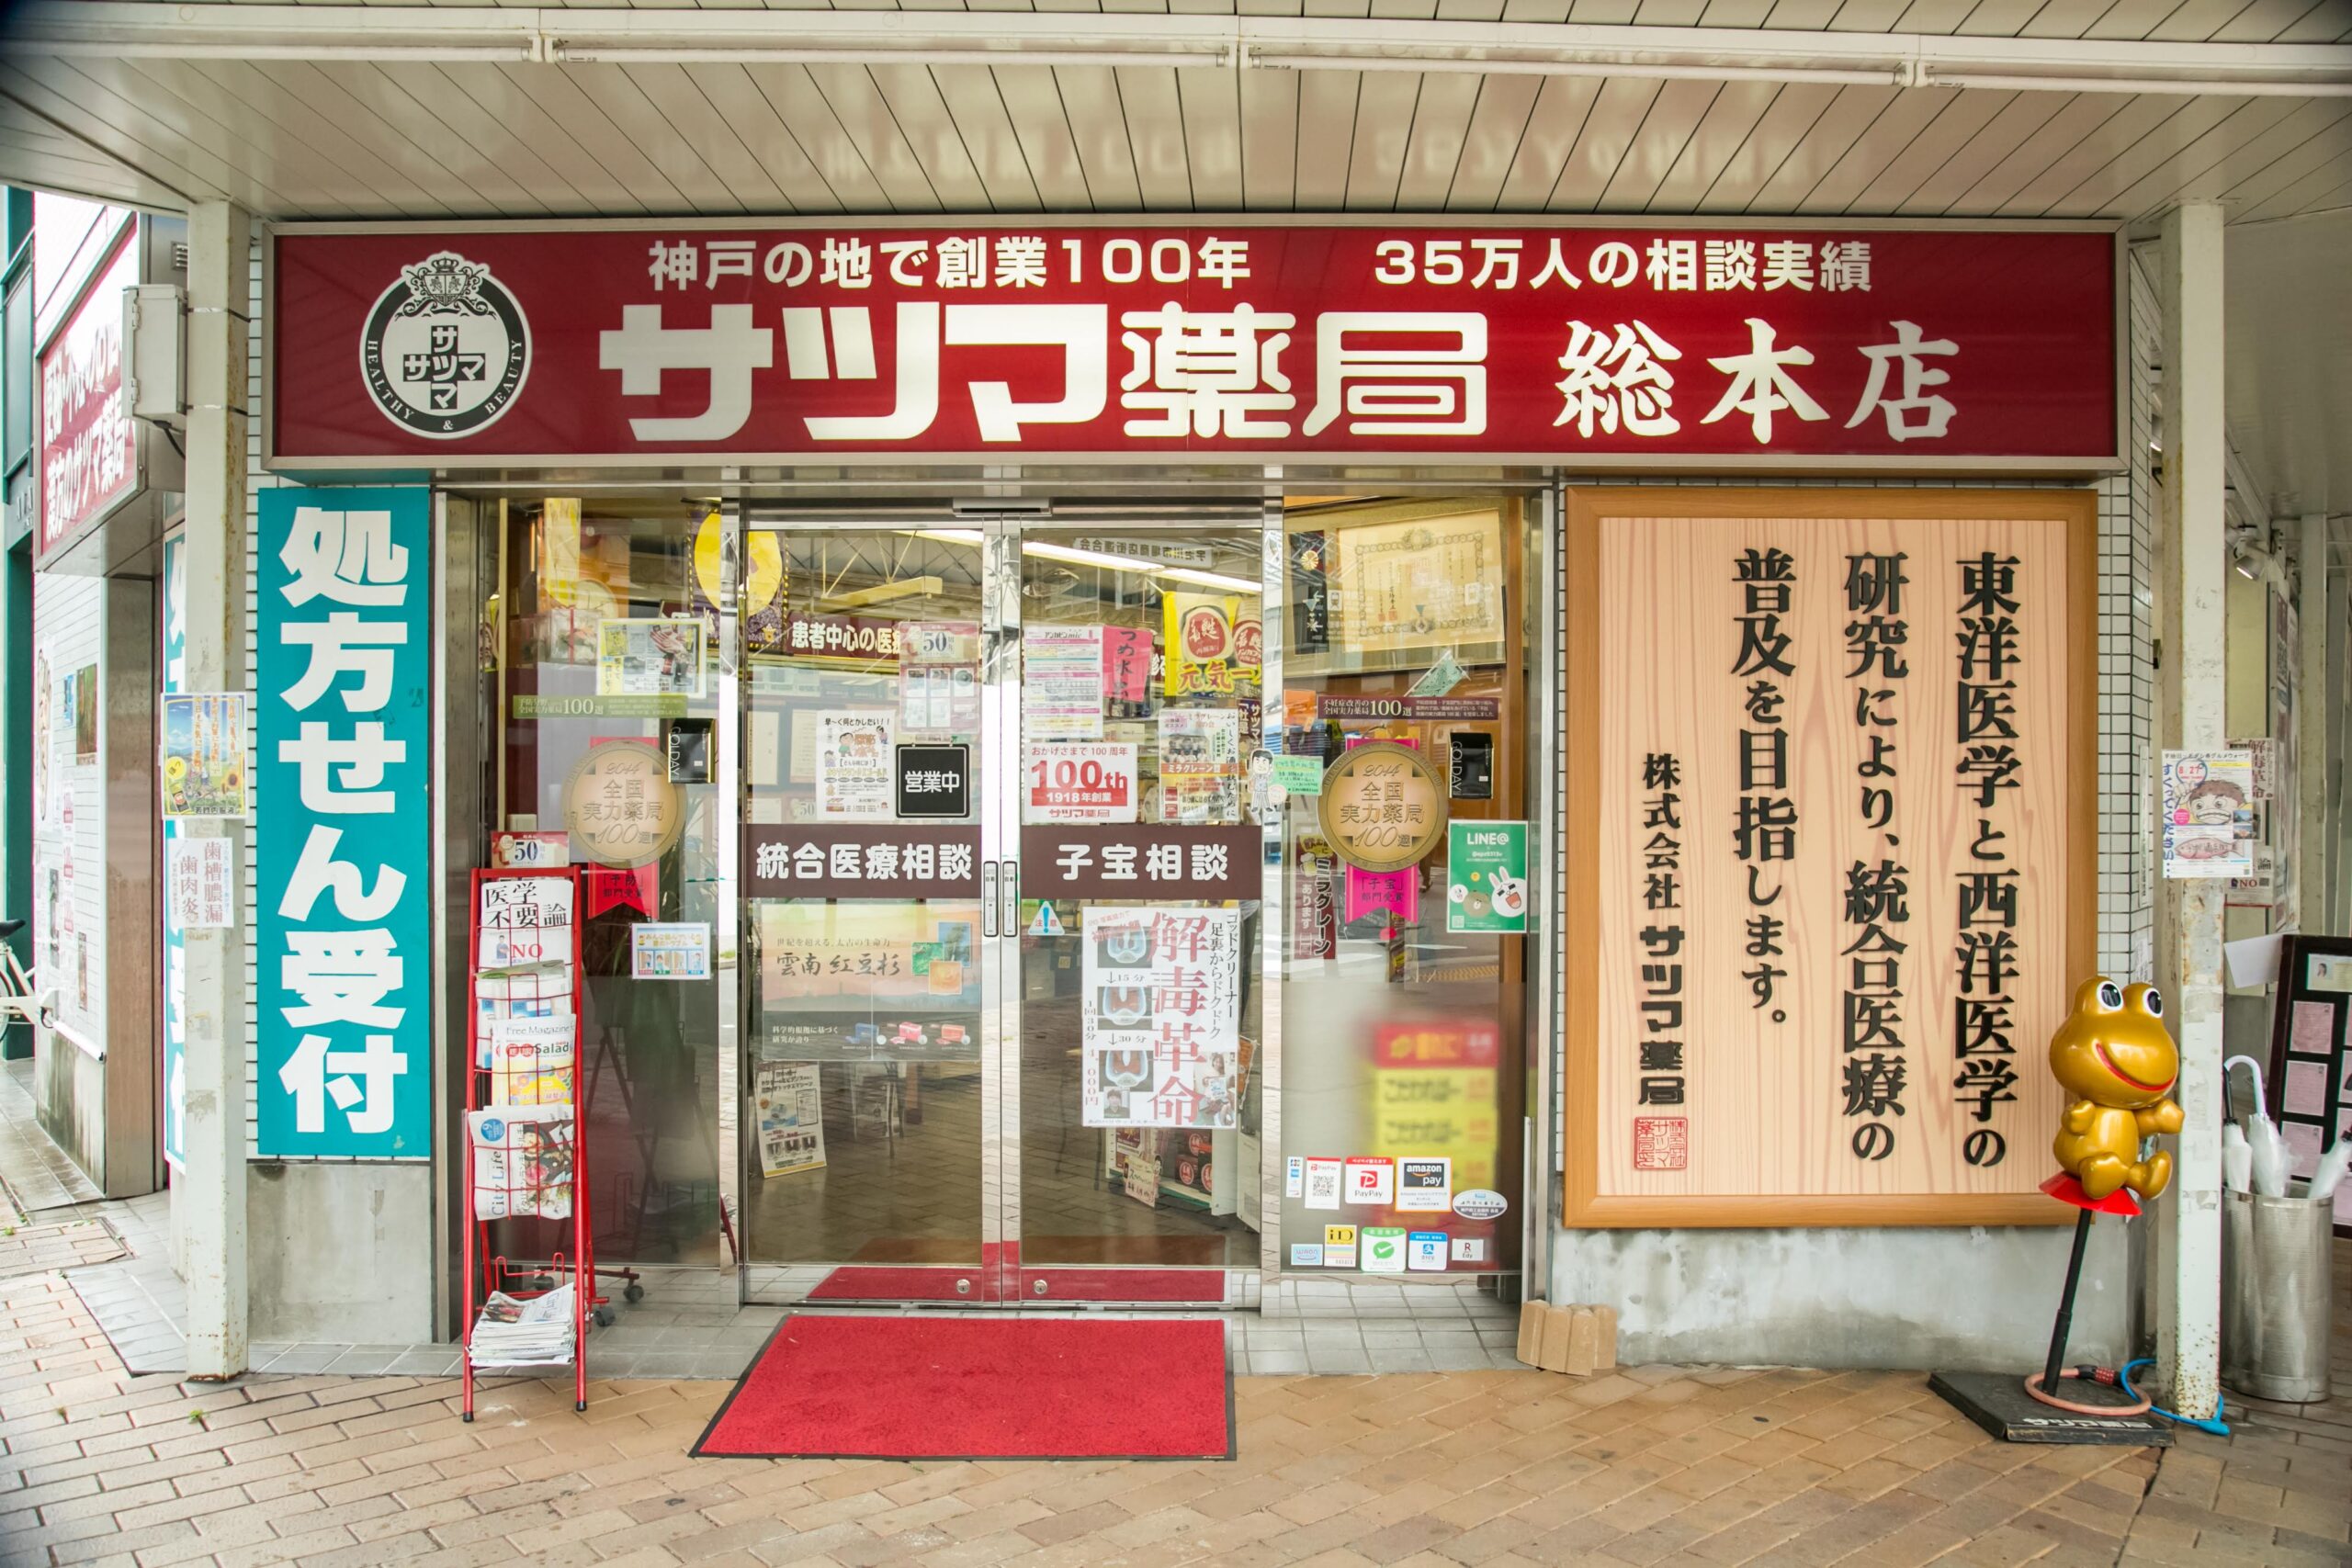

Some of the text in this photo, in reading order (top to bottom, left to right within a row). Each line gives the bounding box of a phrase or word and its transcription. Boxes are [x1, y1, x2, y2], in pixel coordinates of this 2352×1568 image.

[649, 236, 1250, 290] 神戸の地で創業100年
[1374, 237, 1872, 292] 35万人の相談実績
[368, 339, 414, 420] HEALTHY
[484, 340, 522, 414] BEAUTY
[599, 300, 1960, 444] サツマ薬局 総本店
[922, 631, 947, 652] 50
[604, 761, 644, 775] 2014
[1031, 760, 1128, 789] 100th
[1362, 762, 1403, 777] 2014
[603, 779, 645, 800] 全国
[904, 771, 960, 794] 営業中
[1361, 781, 1405, 802] 全国
[1731, 547, 1798, 1025] 普及を目指します。
[1046, 791, 1112, 803] 1918年創業
[277, 506, 409, 1135] 処方せん受付
[582, 801, 664, 821] 実力薬局
[1048, 808, 1111, 818] サツマ薬局
[1340, 803, 1424, 824] 実力薬局
[1466, 832, 1510, 845] LINE@
[514, 840, 538, 862] 50
[755, 841, 973, 881] 統合医療相談
[1056, 843, 1228, 881] 子宝相談
[1841, 551, 1910, 1162] 研究により、統合医療の
[1954, 551, 2021, 1168] 東洋医学と西洋医学の
[1361, 876, 1404, 890] 「子宝」
[485, 881, 537, 908] 医学
[1361, 892, 1404, 903] 部門受賞
[485, 903, 567, 930] 不要論
[1301, 884, 1313, 930] あります
[1315, 858, 1332, 956] ミラグレーン
[511, 942, 544, 959] NO
[776, 952, 821, 976] 雲南
[1145, 911, 1210, 1126] 解毒革命
[506, 1026, 526, 1035] Free
[535, 1042, 570, 1055] Salad
[492, 1150, 504, 1179] Life
[1407, 1164, 1442, 1173] amazon
[1422, 1176, 1442, 1187] pay
[1354, 1190, 1383, 1198] PayPay
